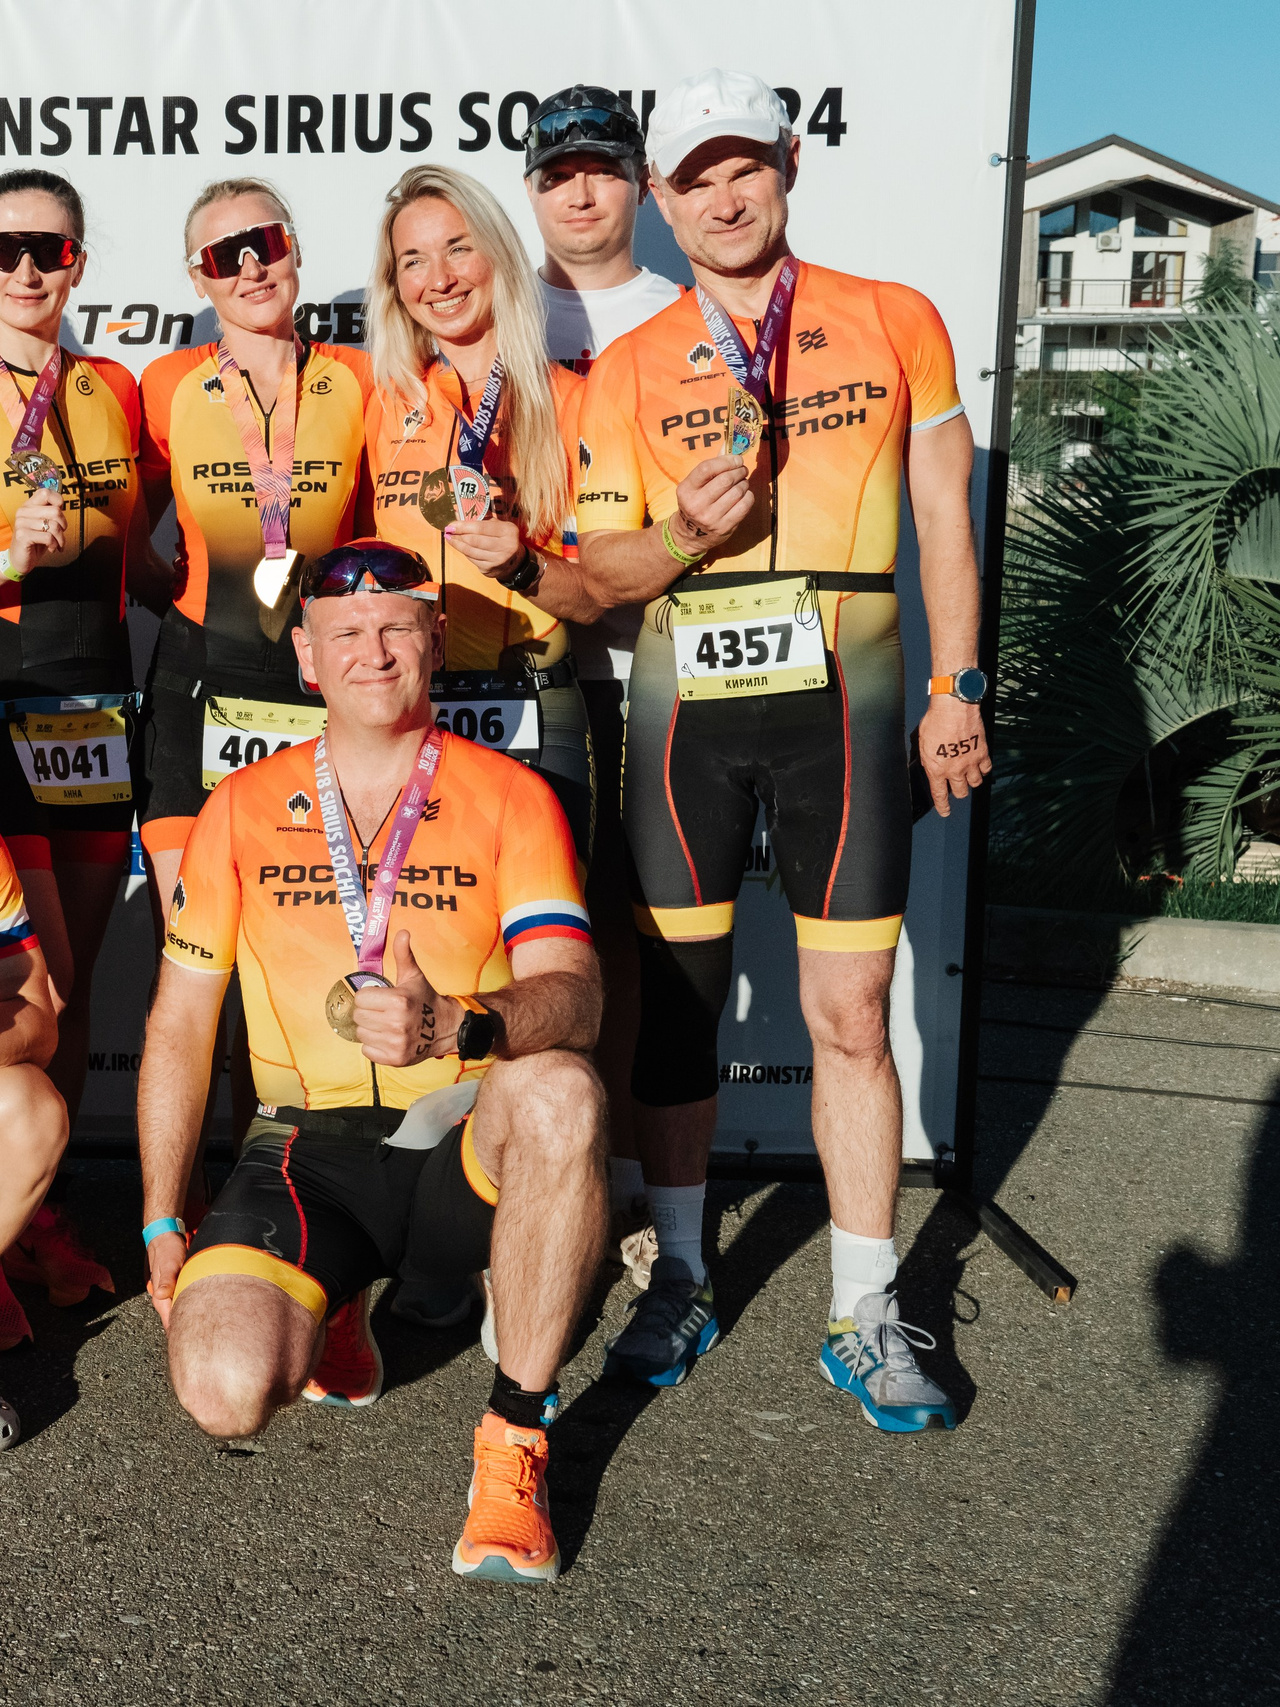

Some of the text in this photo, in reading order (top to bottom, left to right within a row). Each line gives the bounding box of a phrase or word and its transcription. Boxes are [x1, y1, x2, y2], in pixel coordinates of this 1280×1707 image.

[224, 91, 433, 154] SIRIUS
[458, 88, 657, 152] SOI
[706, 312, 728, 348] SIRIUS
[719, 340, 742, 374] SOCHI
[481, 372, 504, 406] SIRIUS
[472, 403, 493, 441] SOCHI
[662, 380, 888, 438] РОСЕФТЬ
[3, 457, 131, 488] RSNEFT
[193, 460, 343, 480] ROSEFT
[24, 478, 127, 498] TATHLON
[208, 480, 328, 495] TRIALON
[241, 497, 302, 508] TM
[458, 480, 477, 495] 113
[696, 622, 793, 670] 4357
[725, 676, 768, 690] КИРИЛЛ
[803, 677, 818, 687] 1/8
[33, 743, 110, 782] 4041
[935, 734, 980, 759] 4357
[315, 762, 332, 790] 1/8
[417, 756, 431, 771] 10
[63, 788, 83, 799] АННА
[318, 790, 344, 843] SIRIUS
[384, 829, 403, 868] ГАЗПРОМБАНК
[328, 845, 358, 899] SOCHI
[273, 890, 458, 912] ТРИЛОН
[367, 895, 384, 937] IRON STAR
[342, 900, 367, 947] 2024
[415, 1002, 436, 1056] 4275
